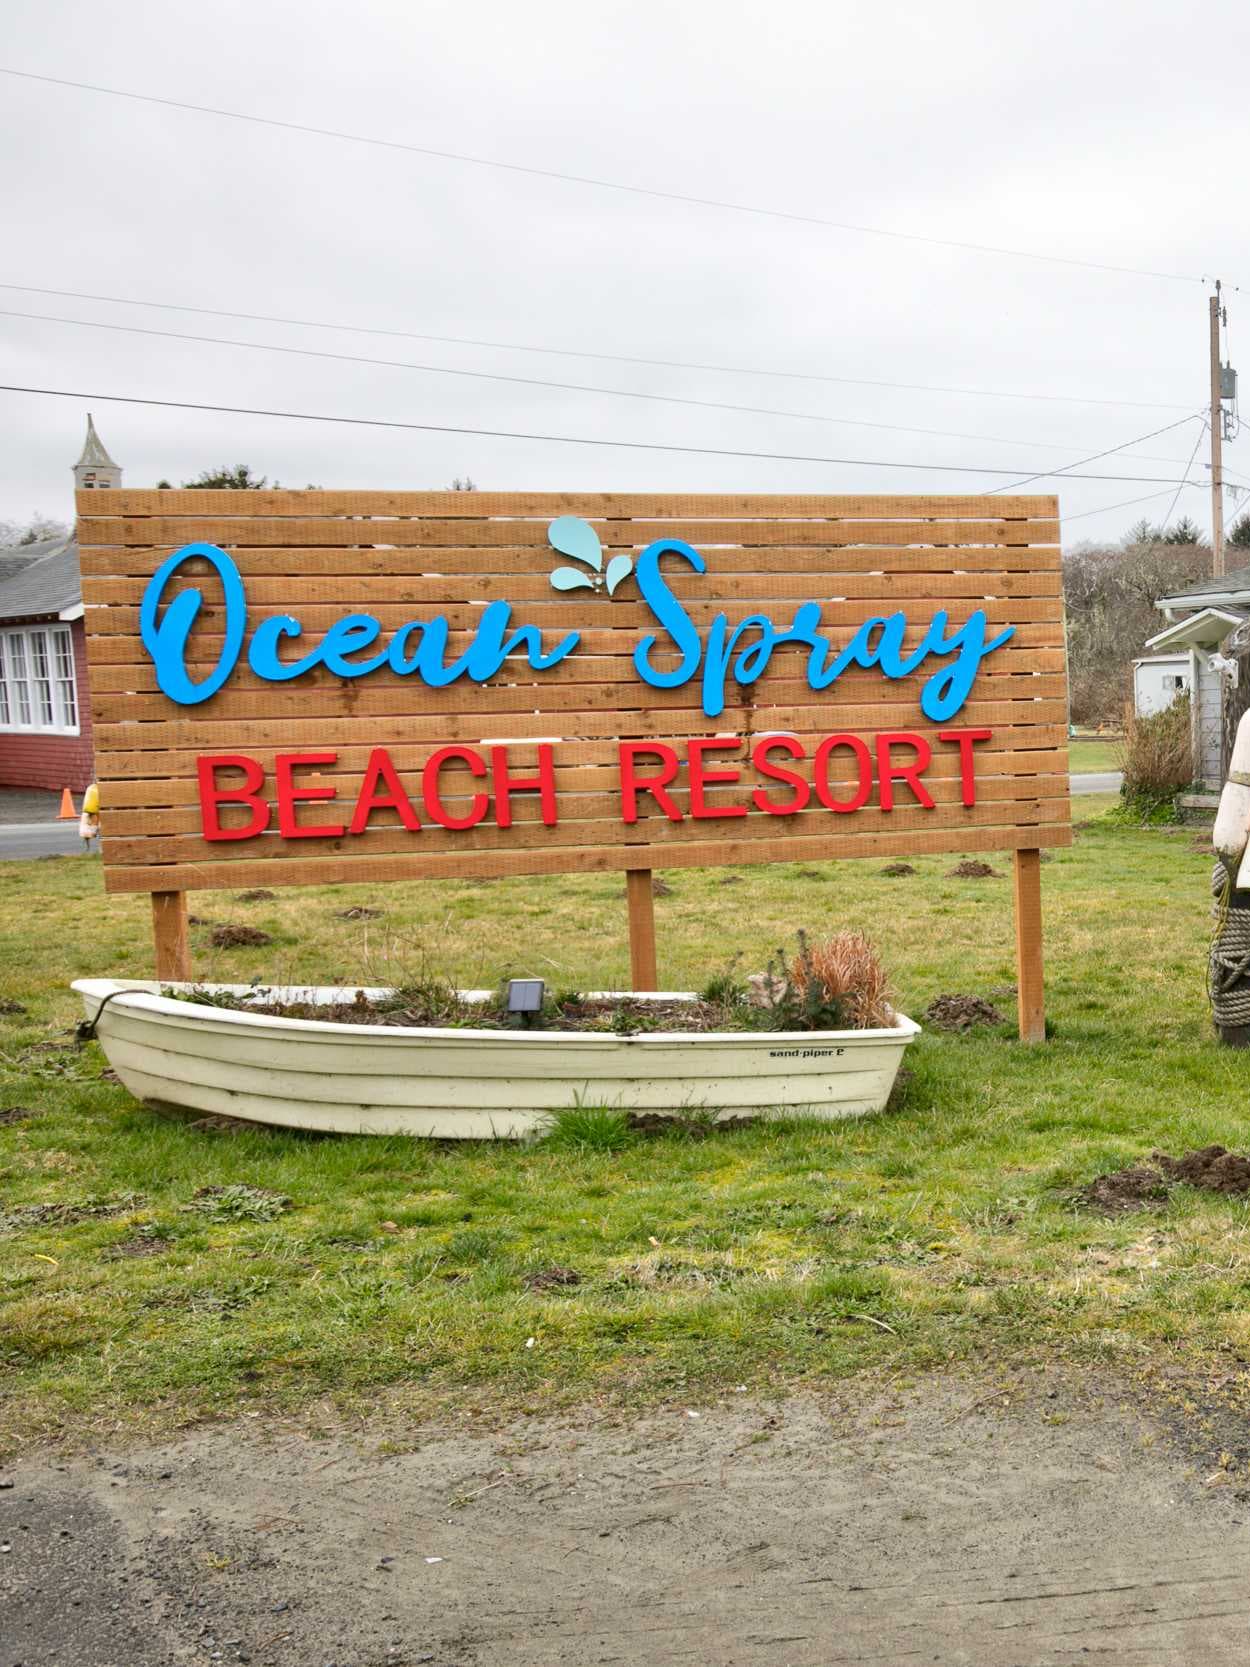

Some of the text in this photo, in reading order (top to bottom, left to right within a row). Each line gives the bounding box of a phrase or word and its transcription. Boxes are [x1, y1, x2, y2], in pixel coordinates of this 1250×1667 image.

[140, 540, 1014, 721] Ocean Spray
[195, 728, 992, 842] BEACH RESORT
